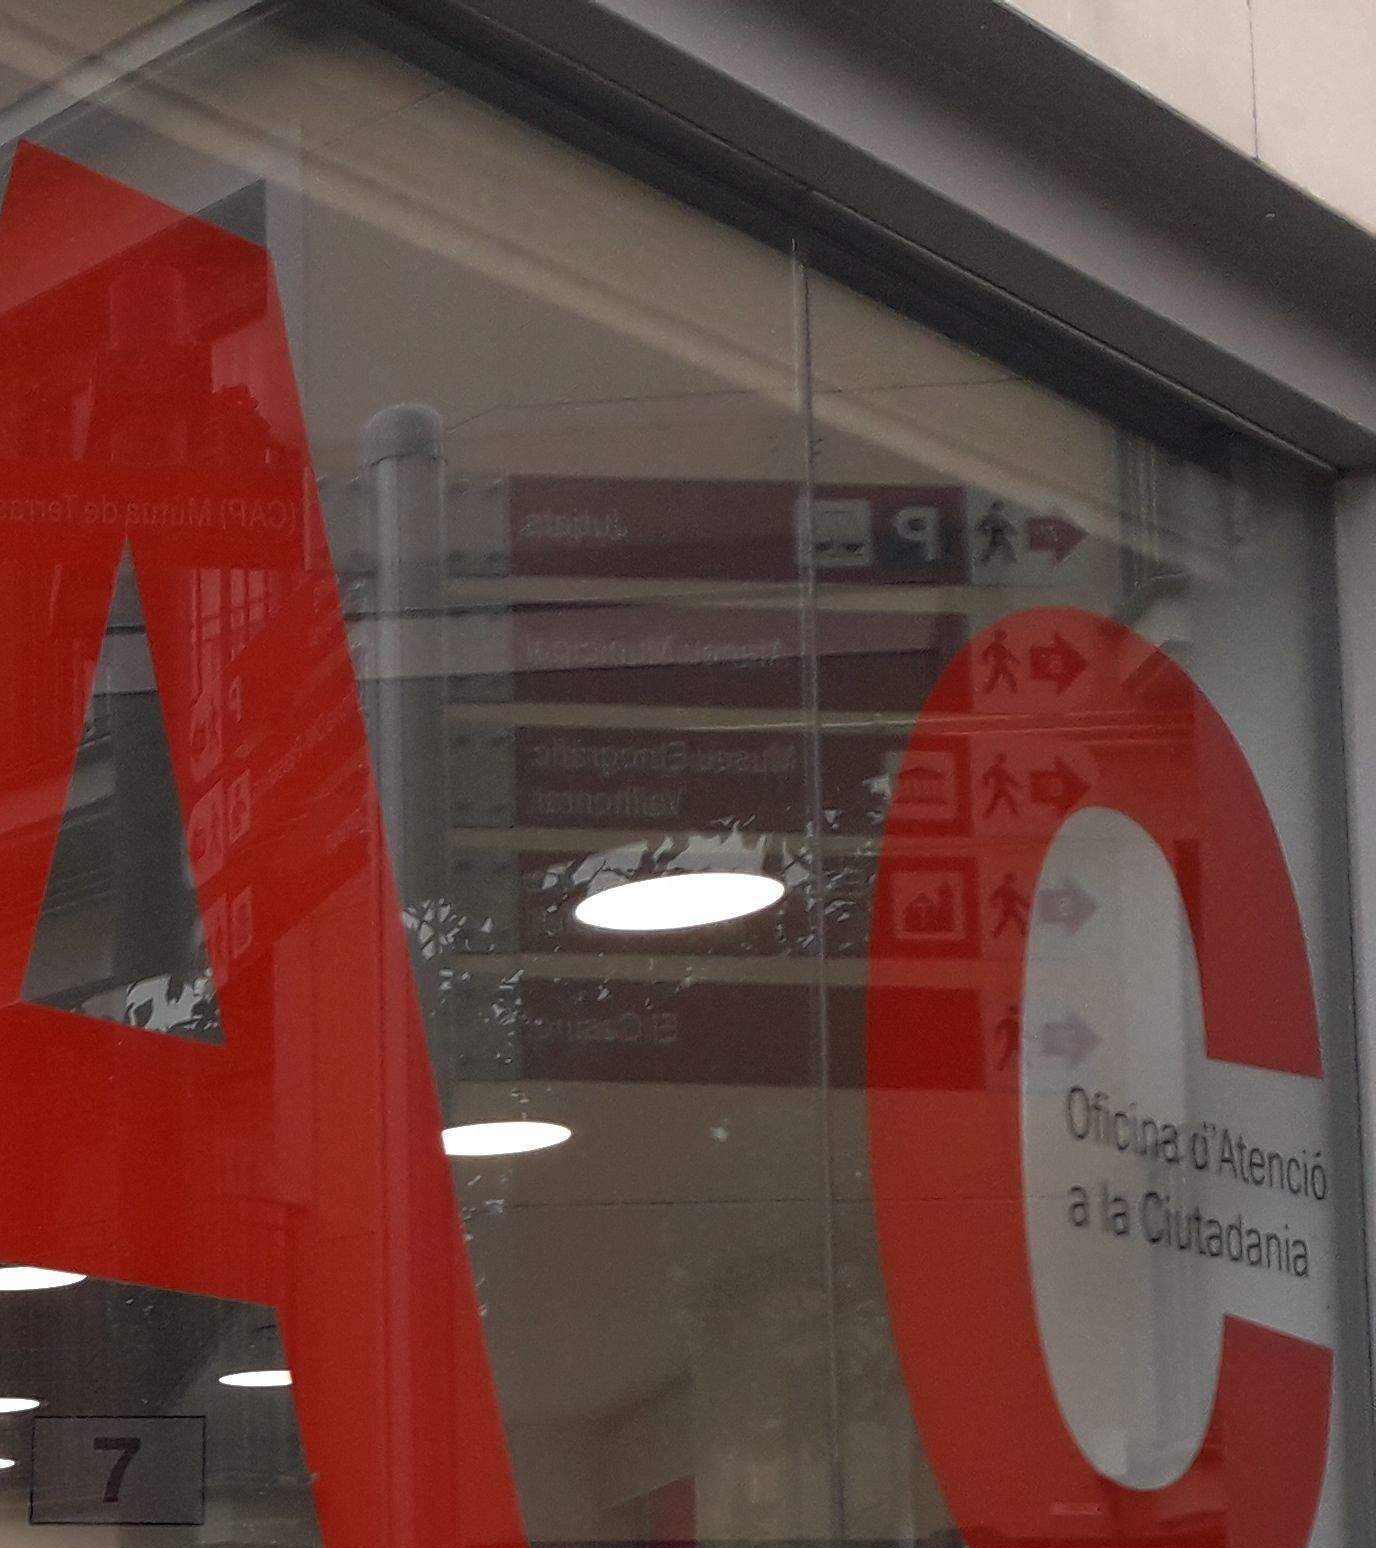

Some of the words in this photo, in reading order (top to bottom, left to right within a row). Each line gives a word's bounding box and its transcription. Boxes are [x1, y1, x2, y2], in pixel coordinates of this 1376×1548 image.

[1068, 1086, 1179, 1164] Oficina
[1191, 1122, 1329, 1201] d'Atenció
[1068, 1185, 1090, 1227] a
[1100, 1184, 1130, 1237] la
[1142, 1192, 1310, 1278] Ciutadania
[93, 1437, 141, 1503] 7
